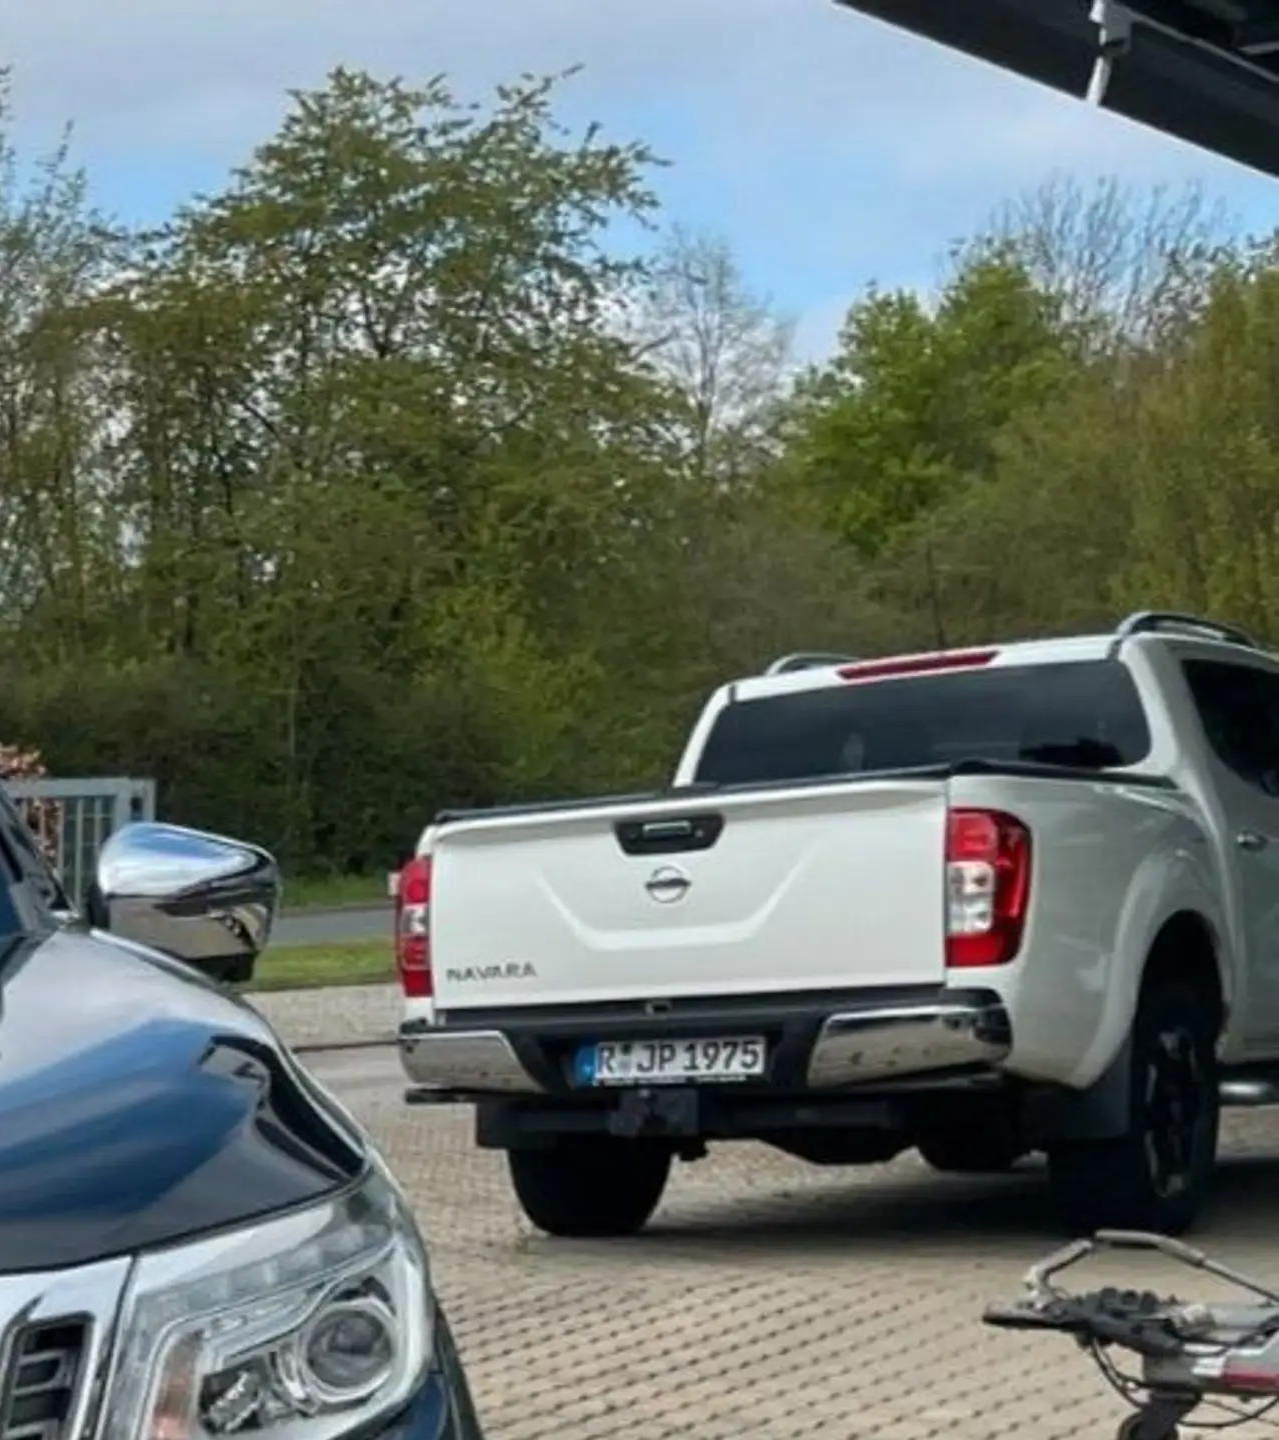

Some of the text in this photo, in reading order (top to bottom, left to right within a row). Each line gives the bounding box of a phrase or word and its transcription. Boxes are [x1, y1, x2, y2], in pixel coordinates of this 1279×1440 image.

[599, 1044, 616, 1073] R
[637, 1044, 677, 1073] JP
[683, 1041, 760, 1070] 1975
